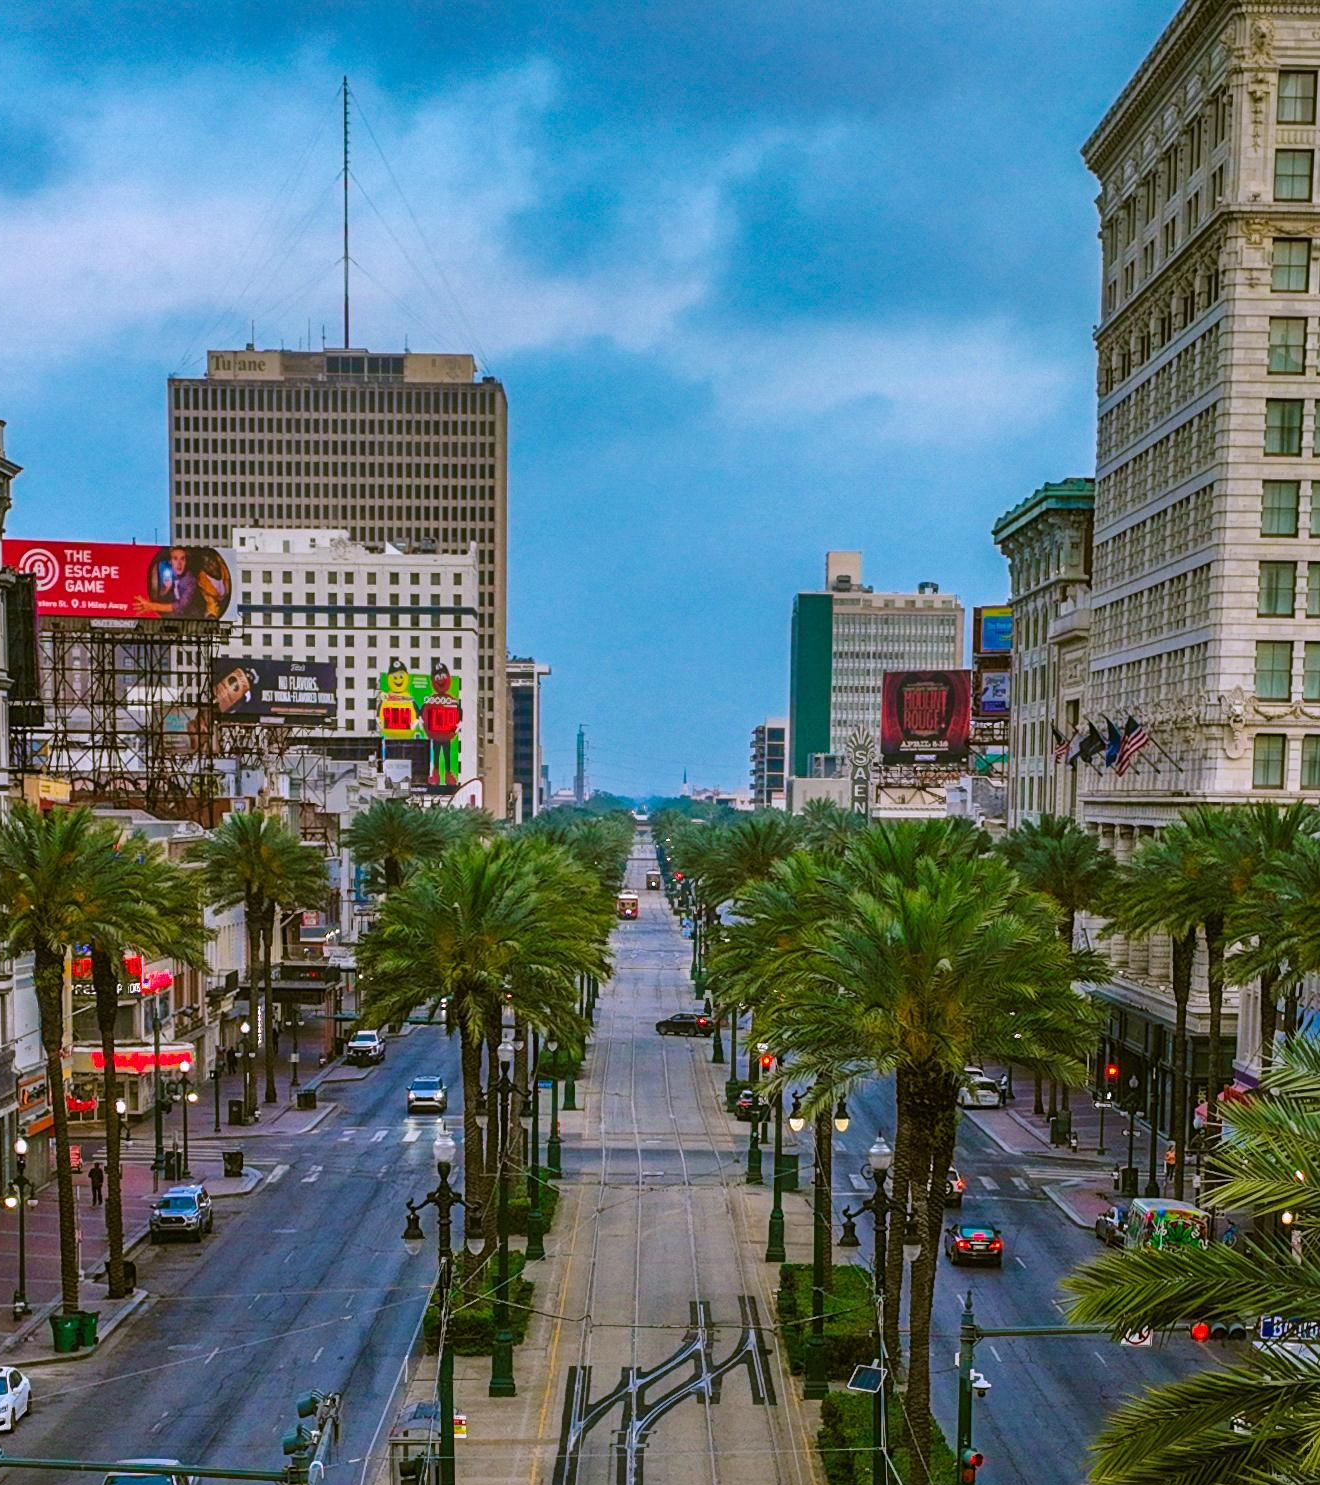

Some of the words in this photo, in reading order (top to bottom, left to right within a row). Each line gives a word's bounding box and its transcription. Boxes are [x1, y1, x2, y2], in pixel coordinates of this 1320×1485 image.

[64, 549, 92, 563] THE
[65, 565, 120, 579] ESCAPE
[65, 579, 105, 593] GAME
[108, 602, 128, 611] Away
[278, 675, 288, 690] NO
[289, 675, 320, 691] FLAVORS.
[854, 750, 868, 815] SAEN
